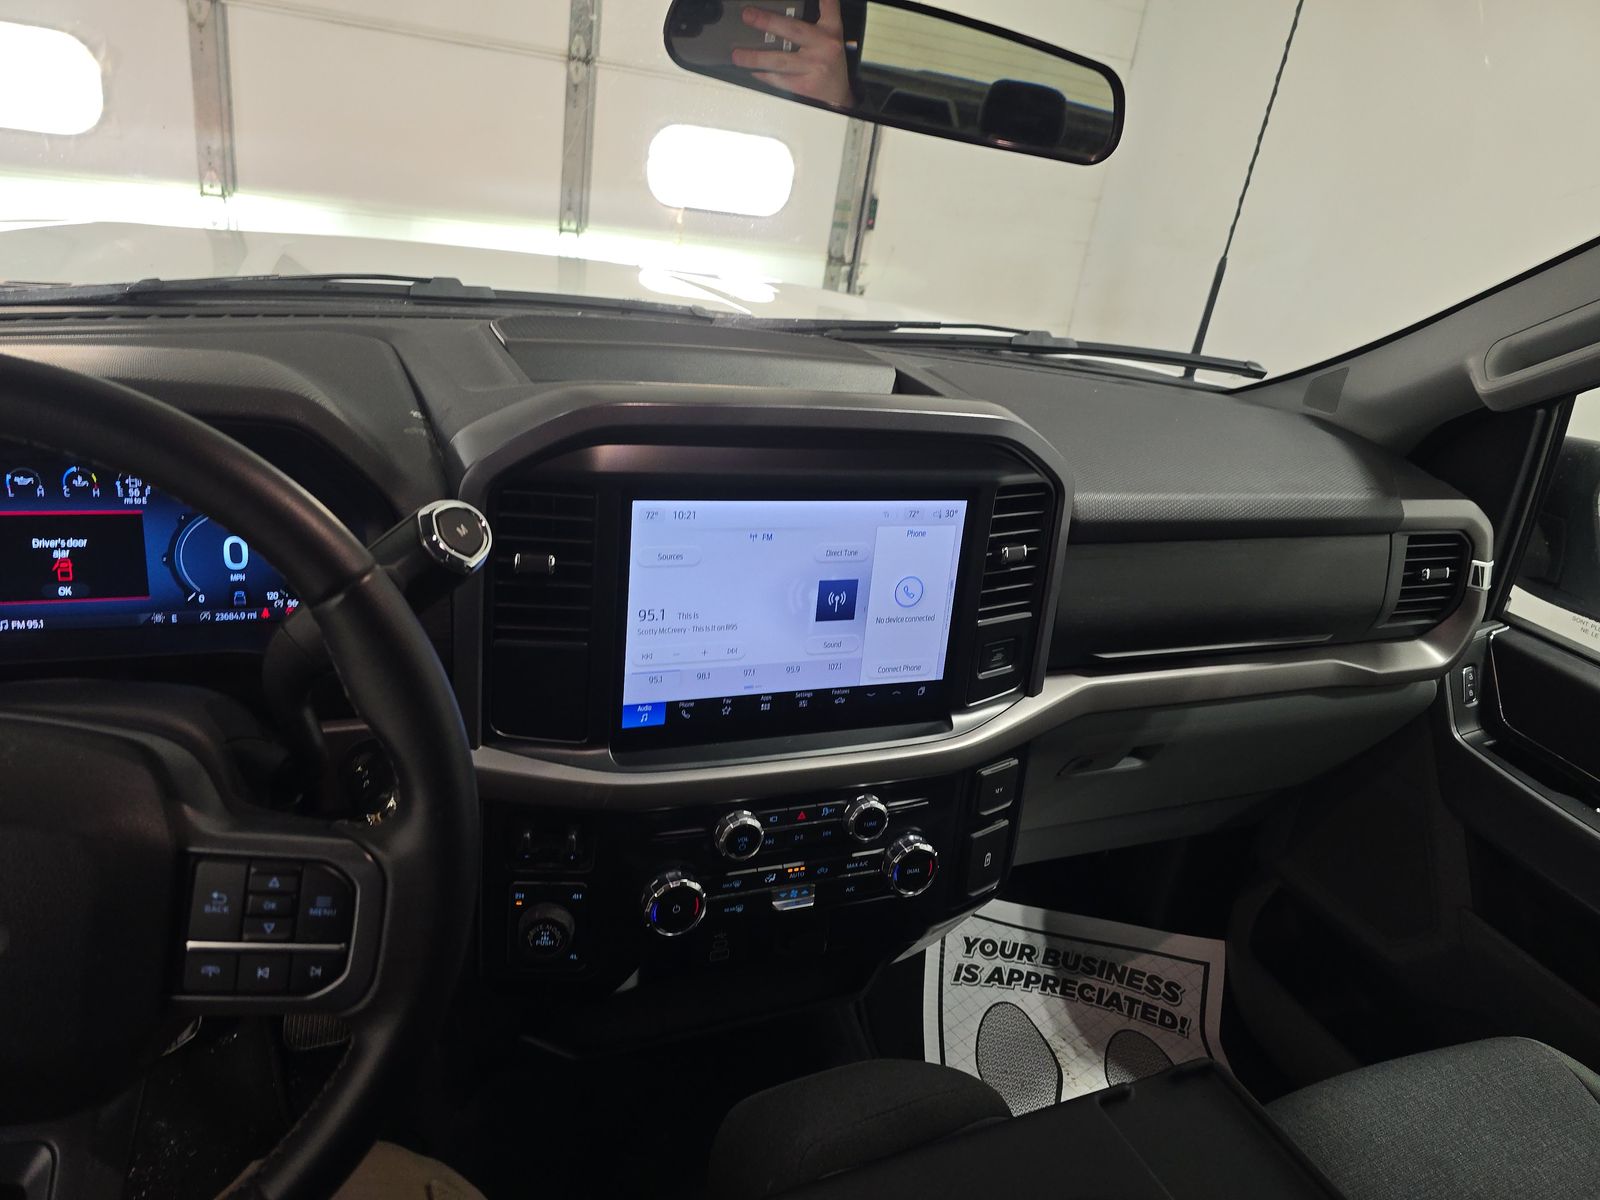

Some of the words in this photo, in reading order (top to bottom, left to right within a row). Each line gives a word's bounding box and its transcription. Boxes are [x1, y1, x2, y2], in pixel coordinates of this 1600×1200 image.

[673, 510, 697, 520] 10:21
[762, 533, 773, 542] FM
[906, 529, 927, 539] Phone
[32, 537, 66, 549] Driver's
[66, 537, 88, 548] door
[52, 548, 70, 560] ajar
[223, 535, 249, 571] 0
[657, 552, 684, 561] Sources
[826, 549, 843, 558] Direct
[843, 548, 859, 557] Tune
[230, 574, 246, 582] MPH
[58, 586, 73, 597] OK
[247, 611, 257, 620] mi
[637, 608, 666, 623] 95.1
[677, 612, 692, 621] This
[875, 616, 886, 624] No
[886, 615, 904, 624] device
[905, 613, 936, 624] connected
[11, 620, 26, 630] FM
[26, 619, 44, 630] 95.1
[637, 627, 657, 637] Scotty
[658, 626, 687, 636] McCreery
[692, 625, 705, 633] This
[823, 640, 842, 649] Sound
[877, 665, 901, 674] Connect
[902, 663, 922, 672] Phone
[795, 690, 813, 699] Settings
[831, 688, 850, 697] Features
[760, 695, 772, 703] Apps
[637, 704, 652, 712] Audio
[679, 701, 695, 709] Phone
[737, 836, 749, 844] VOL
[906, 867, 921, 875] DUAL
[204, 905, 230, 914] BACK
[263, 902, 276, 910] OK
[309, 908, 337, 917] MENU
[962, 936, 1038, 963] YOUR
[1041, 946, 1185, 1006] BUSINESS
[952, 963, 983, 984] IS
[985, 966, 1192, 1038] APPRECIATED!
